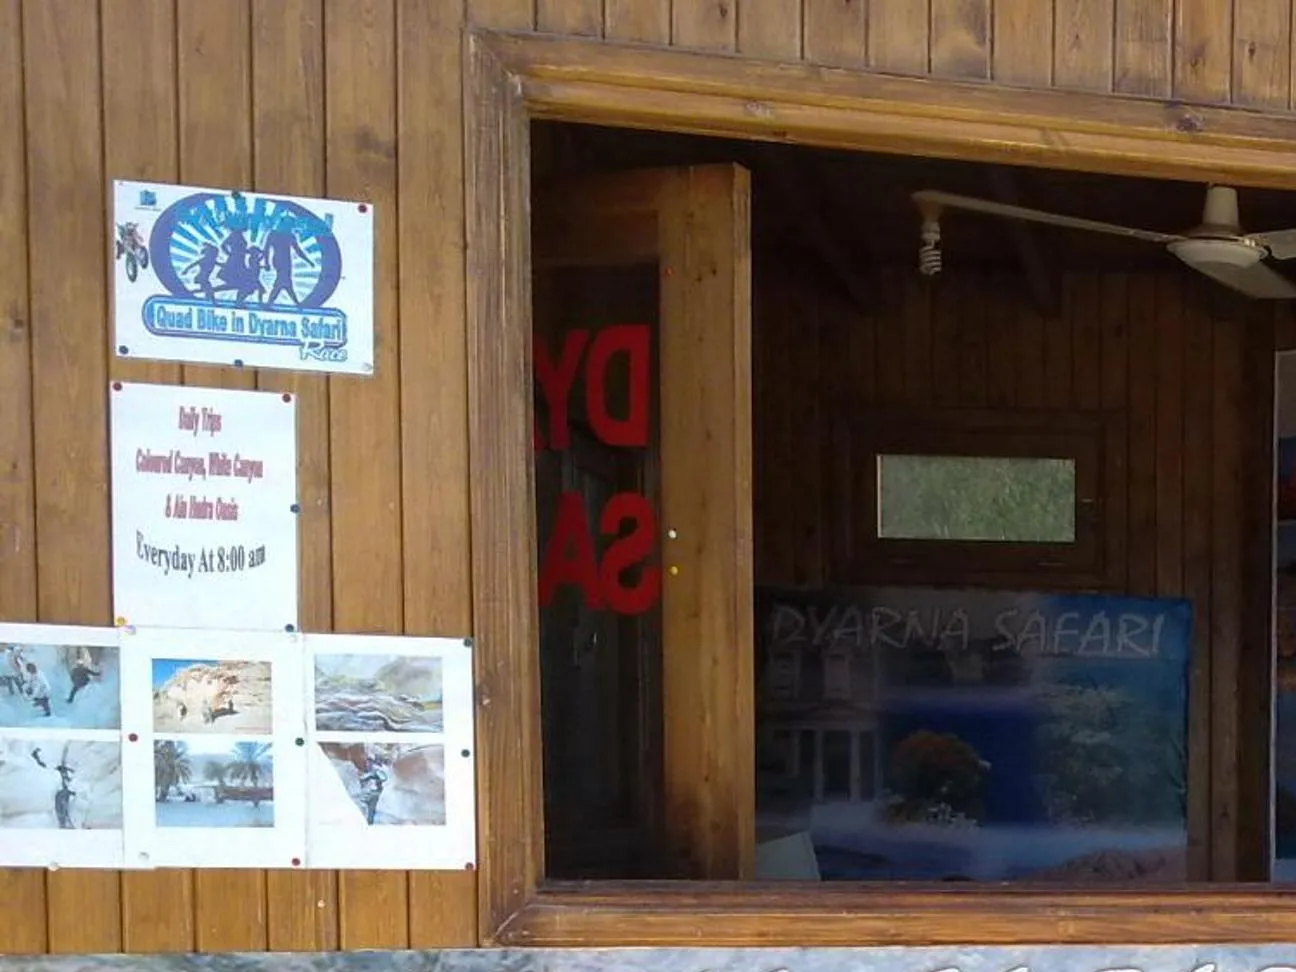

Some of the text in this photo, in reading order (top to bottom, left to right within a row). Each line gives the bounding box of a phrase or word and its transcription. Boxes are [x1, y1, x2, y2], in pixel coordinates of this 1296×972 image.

[156, 305, 342, 340] Quad Bike in Dyarna Safari
[300, 340, 348, 362] Race
[178, 405, 222, 437] Daily Trips
[136, 529, 266, 579] Everyday At 8:00 am
[771, 603, 1165, 657] DYARNA SAFARI
